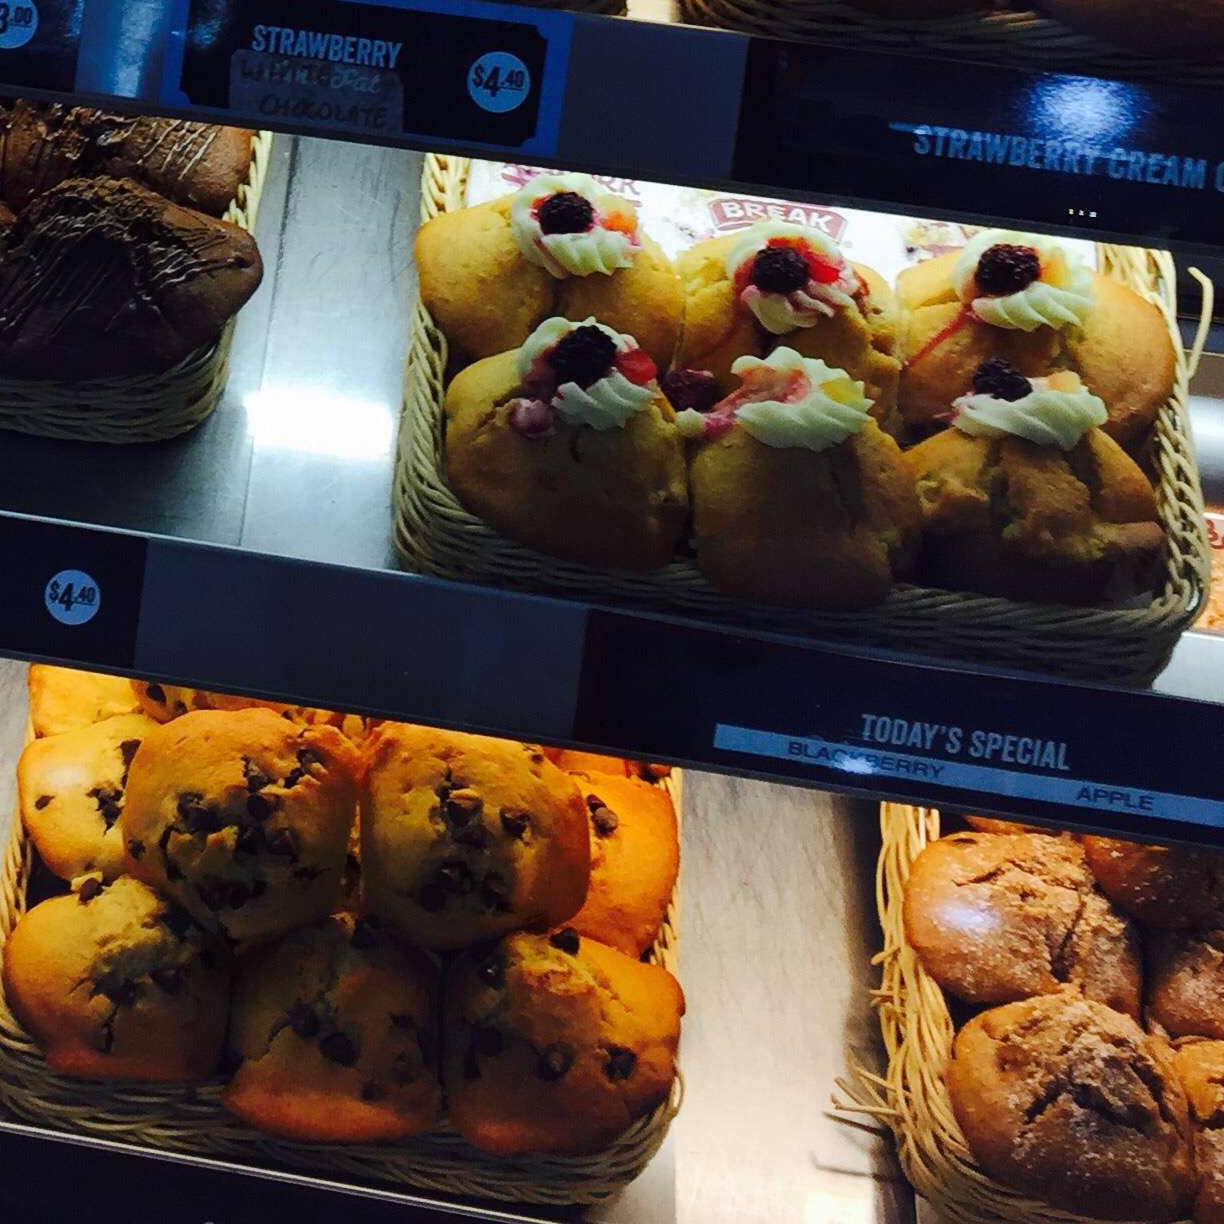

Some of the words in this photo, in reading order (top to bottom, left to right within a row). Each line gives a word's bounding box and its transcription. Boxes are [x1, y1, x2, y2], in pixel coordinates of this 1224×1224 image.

[251, 24, 404, 69] STRAWBERRY
[913, 125, 1098, 176] STRAWBERRY
[1108, 146, 1207, 191] CREAM
[721, 202, 833, 232] BREAK
[861, 712, 963, 757] TODAY'S
[970, 729, 1072, 772] SPECIAL
[1075, 785, 1155, 812] APPLE
